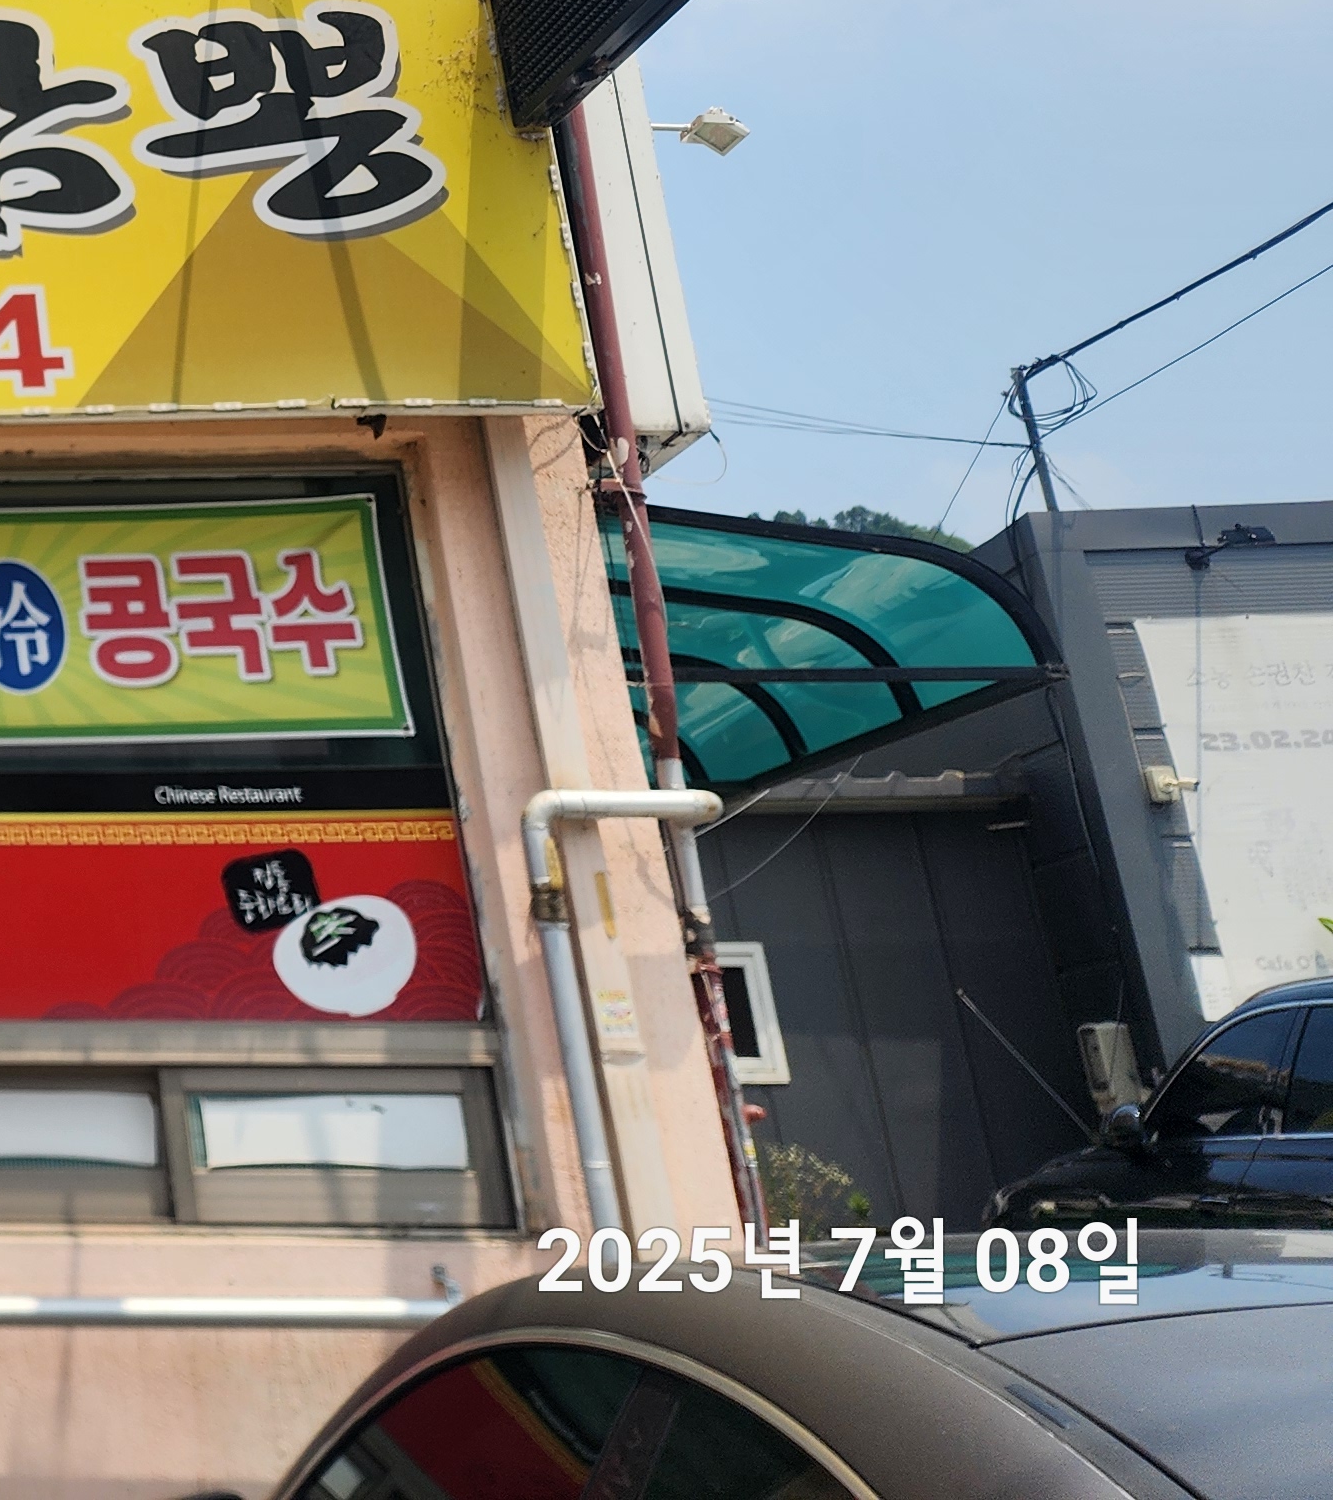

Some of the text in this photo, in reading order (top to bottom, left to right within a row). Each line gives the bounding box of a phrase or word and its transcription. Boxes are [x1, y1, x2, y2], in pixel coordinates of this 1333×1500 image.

[79, 550, 363, 686] 콩국수
[155, 785, 303, 804] Chinese Restaurant
